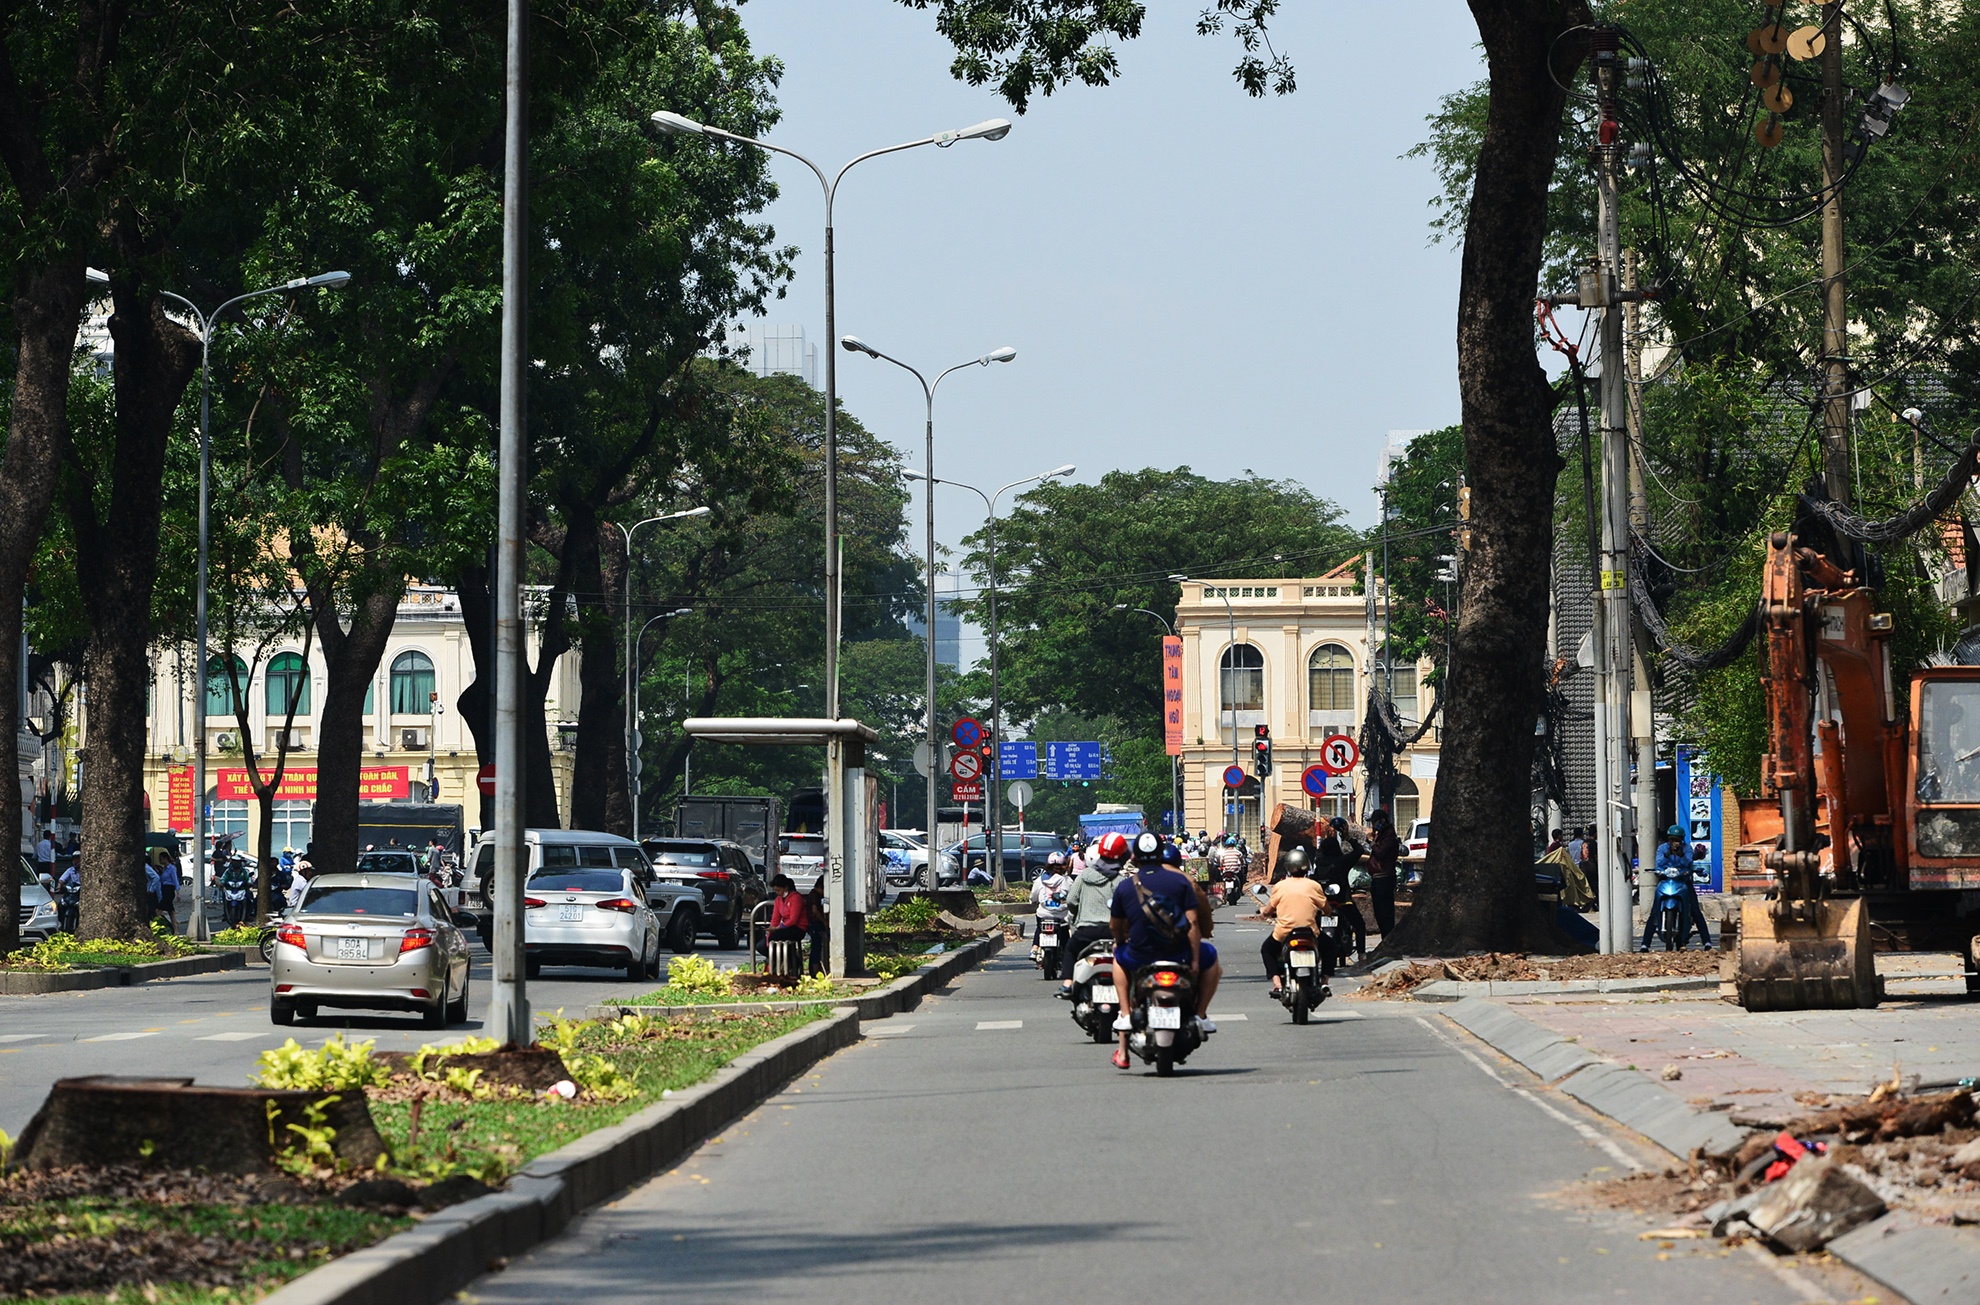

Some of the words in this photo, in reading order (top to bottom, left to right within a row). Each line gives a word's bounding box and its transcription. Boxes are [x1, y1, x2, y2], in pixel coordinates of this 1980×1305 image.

[227, 773, 242, 782] XÂY
[284, 773, 304, 783] TRẬN
[233, 784, 249, 794] THẾ
[285, 786, 304, 794] NINH
[371, 783, 392, 793] CHẮC
[957, 783, 976, 793] CẤM
[345, 939, 361, 948] 60A
